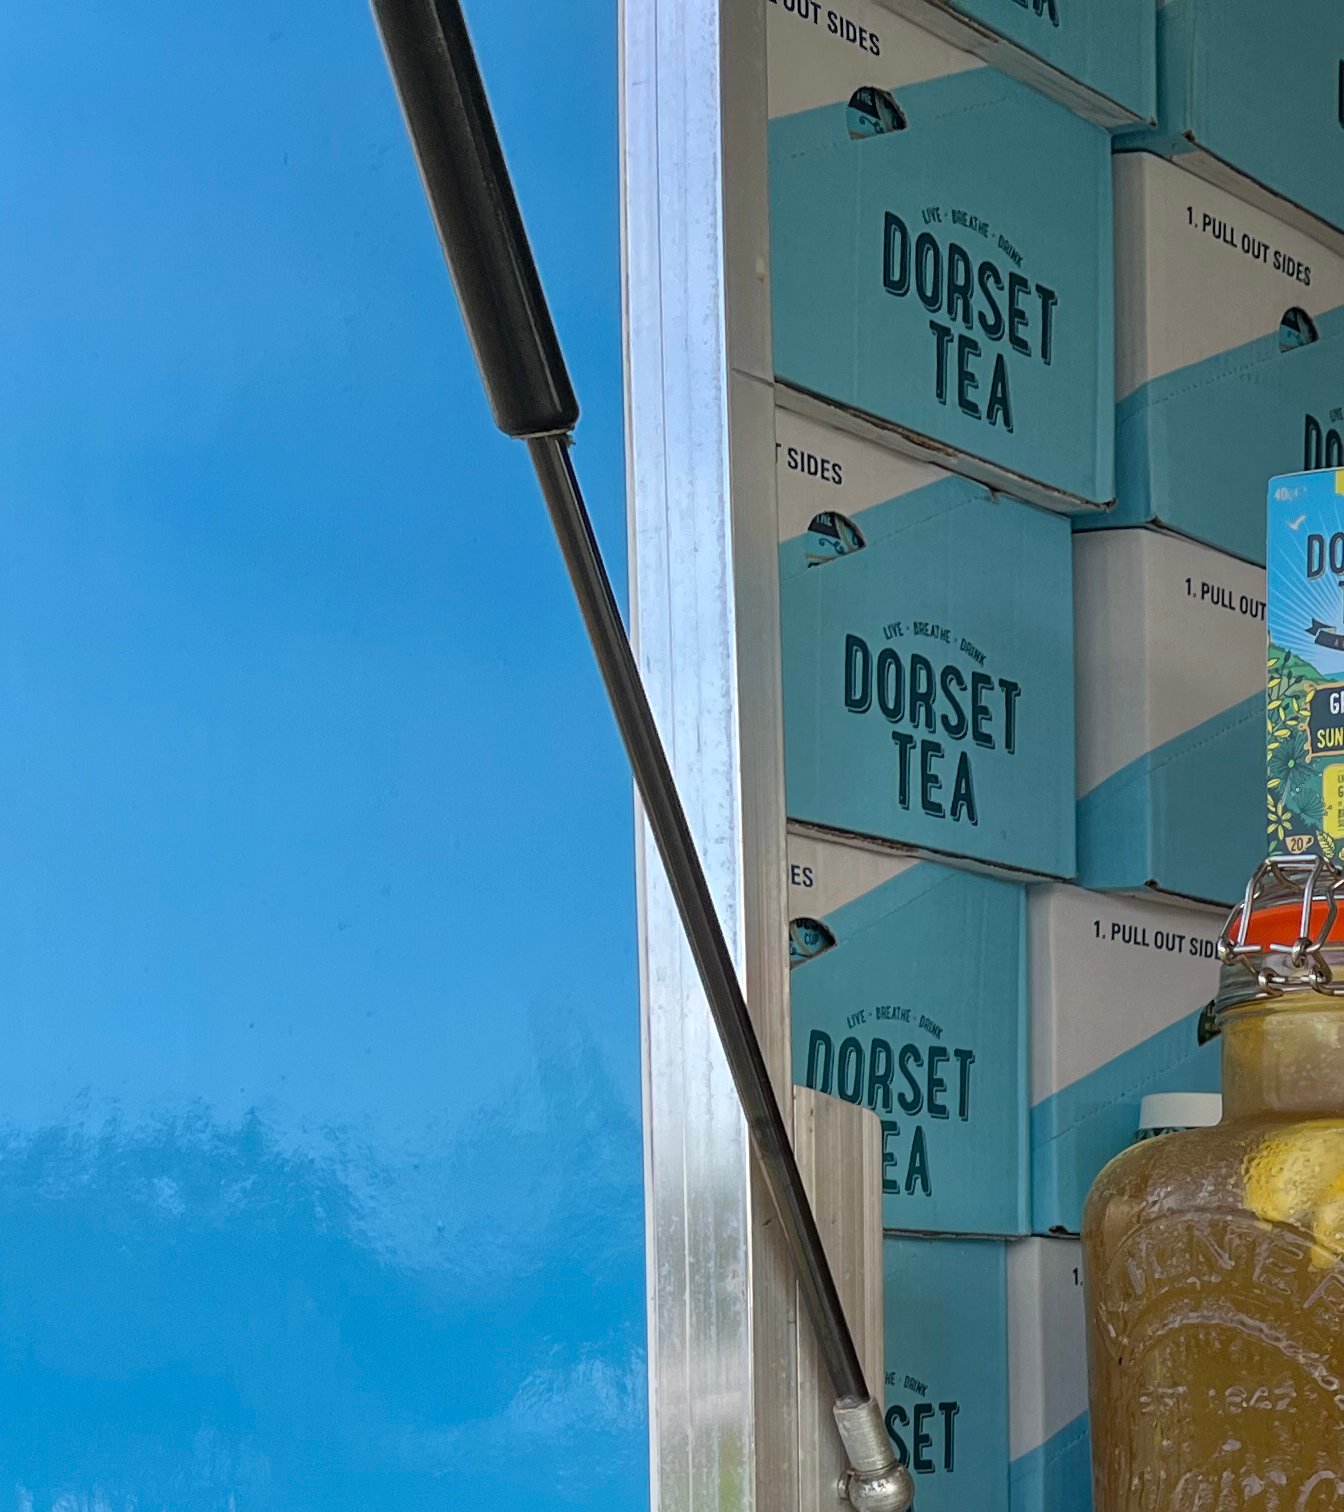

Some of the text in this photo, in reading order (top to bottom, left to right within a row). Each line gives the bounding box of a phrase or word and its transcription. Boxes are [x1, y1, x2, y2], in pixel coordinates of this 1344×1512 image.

[827, 10, 880, 57] SIDES
[1186, 206, 1311, 287] 1. PULL OUT SIDES
[882, 210, 1058, 366] DORSET
[929, 319, 1015, 433] TEA
[787, 447, 842, 486] SIDES
[883, 621, 904, 641] LIVE
[913, 621, 951, 644] BREATHE
[1185, 577, 1267, 621] 1. PULL OUT
[844, 633, 1022, 755] DORSET
[892, 730, 978, 826] TEA
[1290, 837, 1304, 852] 20
[1094, 920, 1106, 940] 1.
[1111, 922, 1150, 948] PULL
[1154, 931, 1186, 954] OUT
[846, 1005, 944, 1040] LIVE BREATHE DRINK
[806, 1028, 976, 1122] DORSET
[882, 1120, 932, 1197] EA
[885, 1401, 961, 1473] SET
